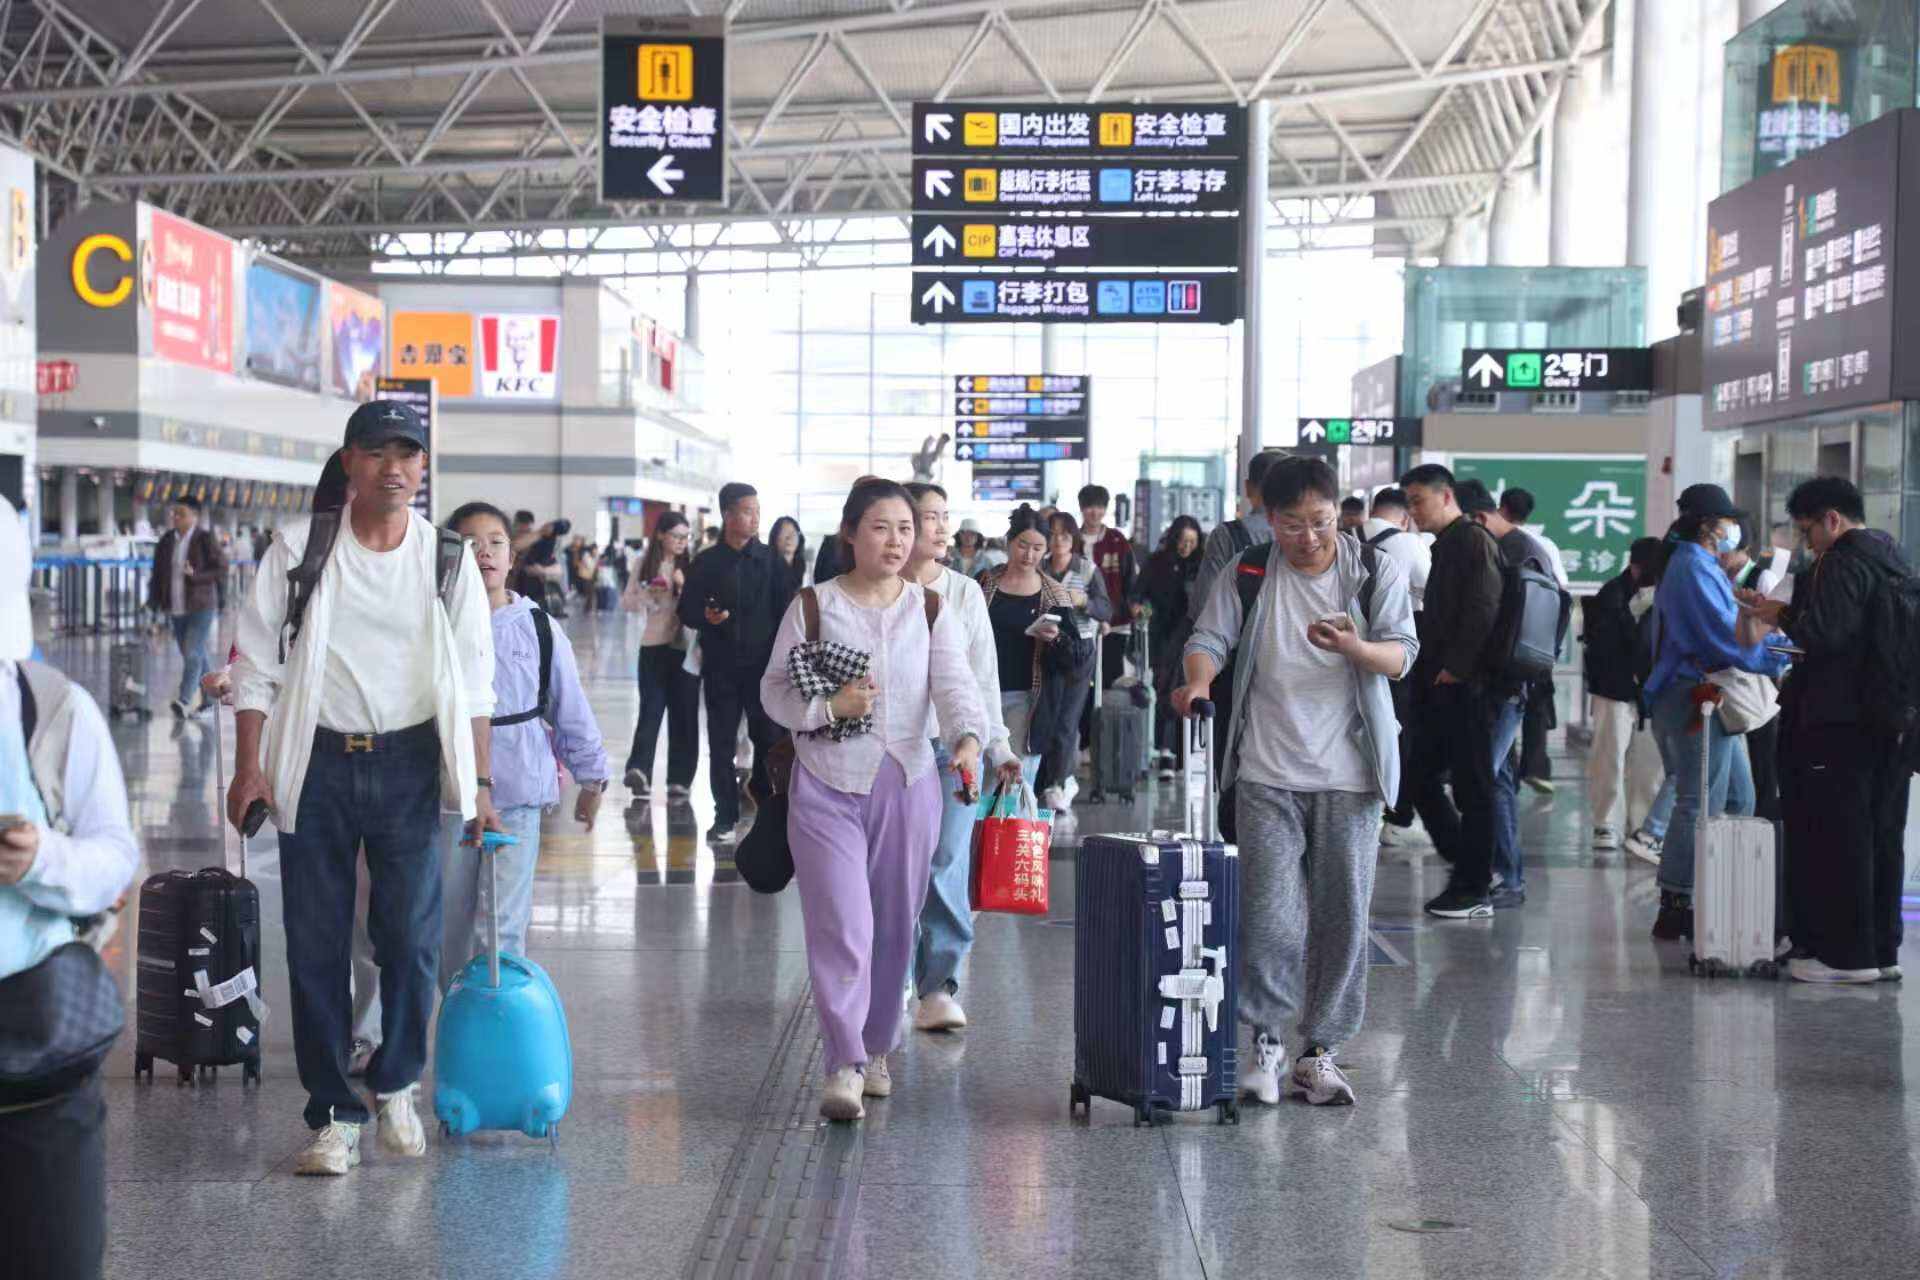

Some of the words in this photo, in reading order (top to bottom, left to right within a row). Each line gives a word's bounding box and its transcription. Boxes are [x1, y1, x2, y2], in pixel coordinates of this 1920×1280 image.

[609, 105, 716, 134] 安全检查
[999, 112, 1090, 136] 国内出发
[1134, 112, 1226, 135] 安全检查
[668, 134, 712, 148] Check
[1134, 168, 1226, 192] 行李寄存
[967, 234, 992, 247] CIP
[72, 233, 134, 308] C
[998, 281, 1088, 304] 行李打包
[1544, 353, 1608, 378] 2号门
[496, 376, 544, 392] KFC
[1014, 829, 1030, 901] 三关六码头
[1031, 830, 1044, 903] 特色风味礼
